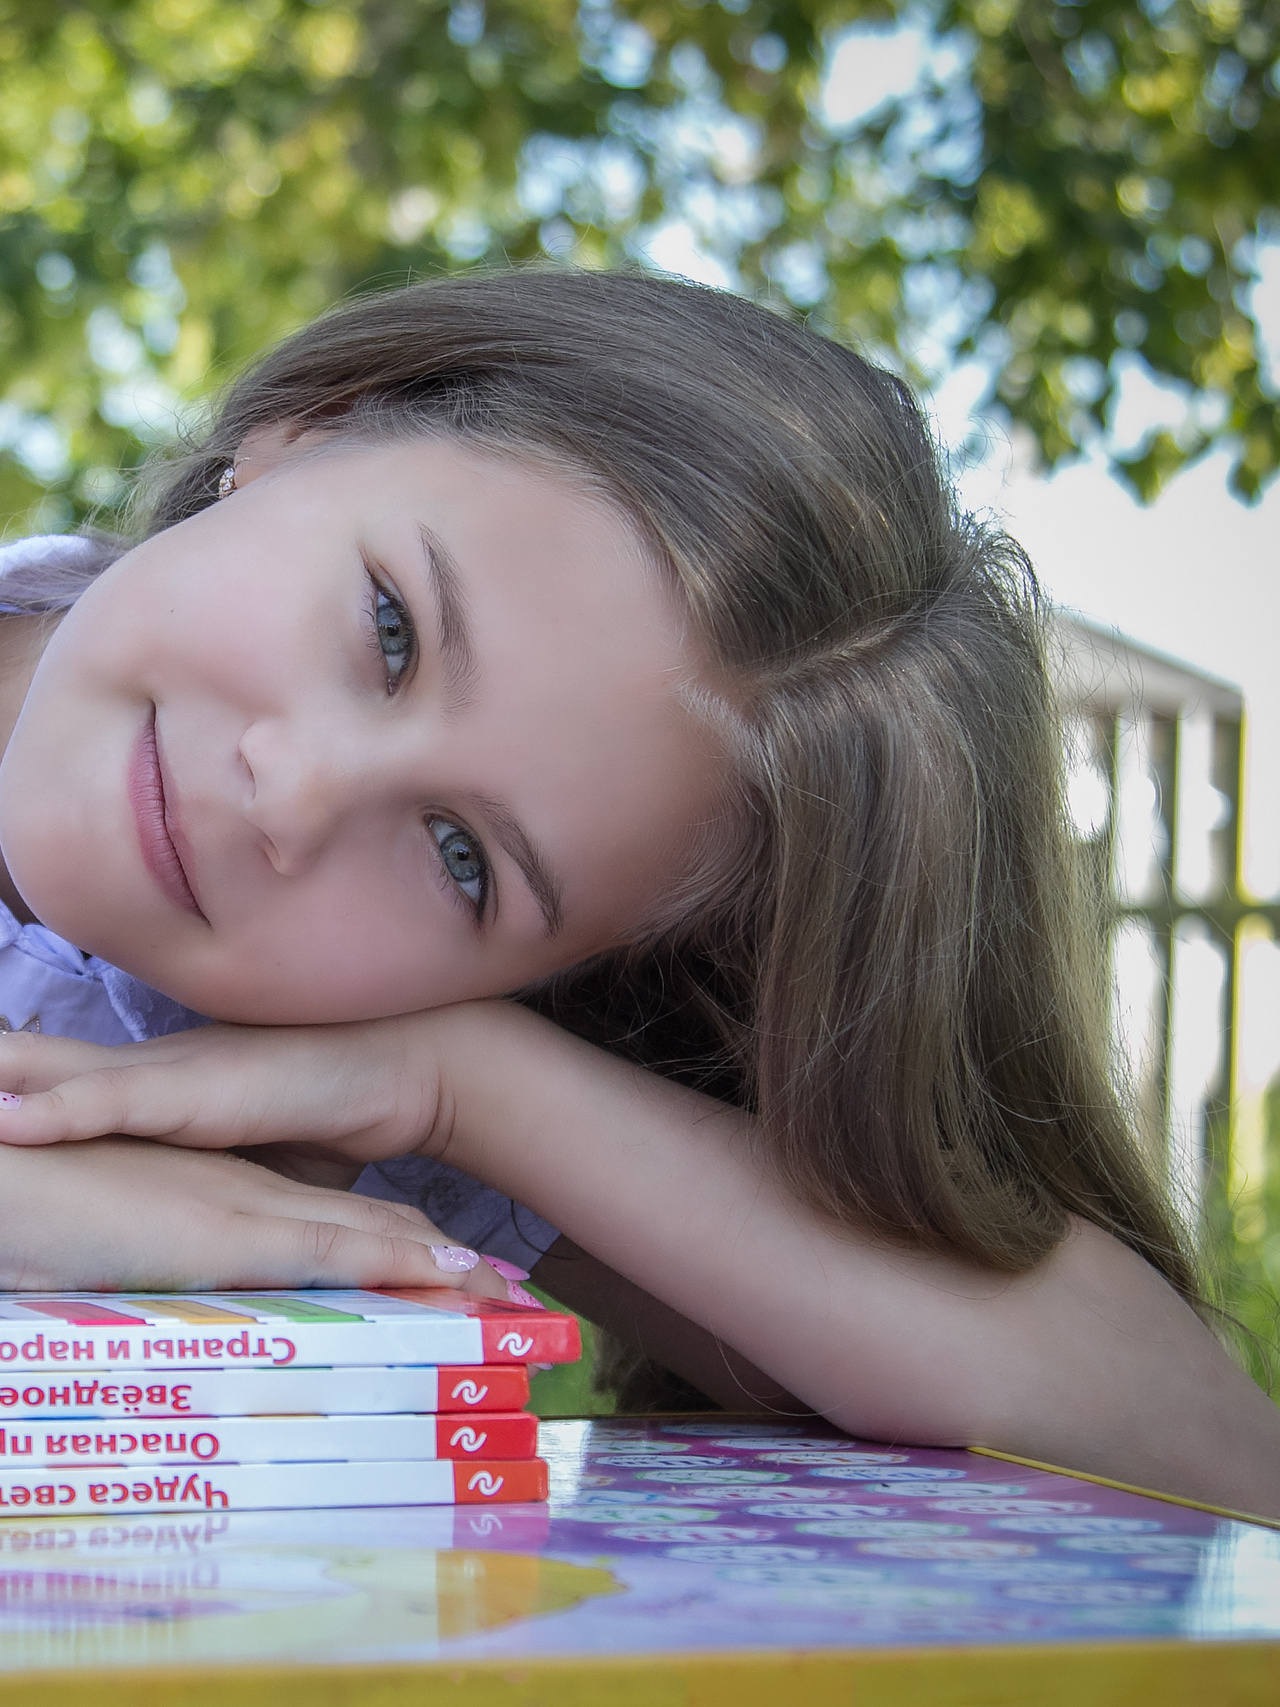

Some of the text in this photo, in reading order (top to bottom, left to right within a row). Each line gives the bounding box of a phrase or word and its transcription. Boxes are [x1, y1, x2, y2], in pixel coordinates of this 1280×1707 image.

[108, 1340, 130, 1360] и
[143, 1331, 297, 1366] Страны
[46, 1432, 221, 1461] Опасная
[89, 1473, 229, 1509] Чудеса
